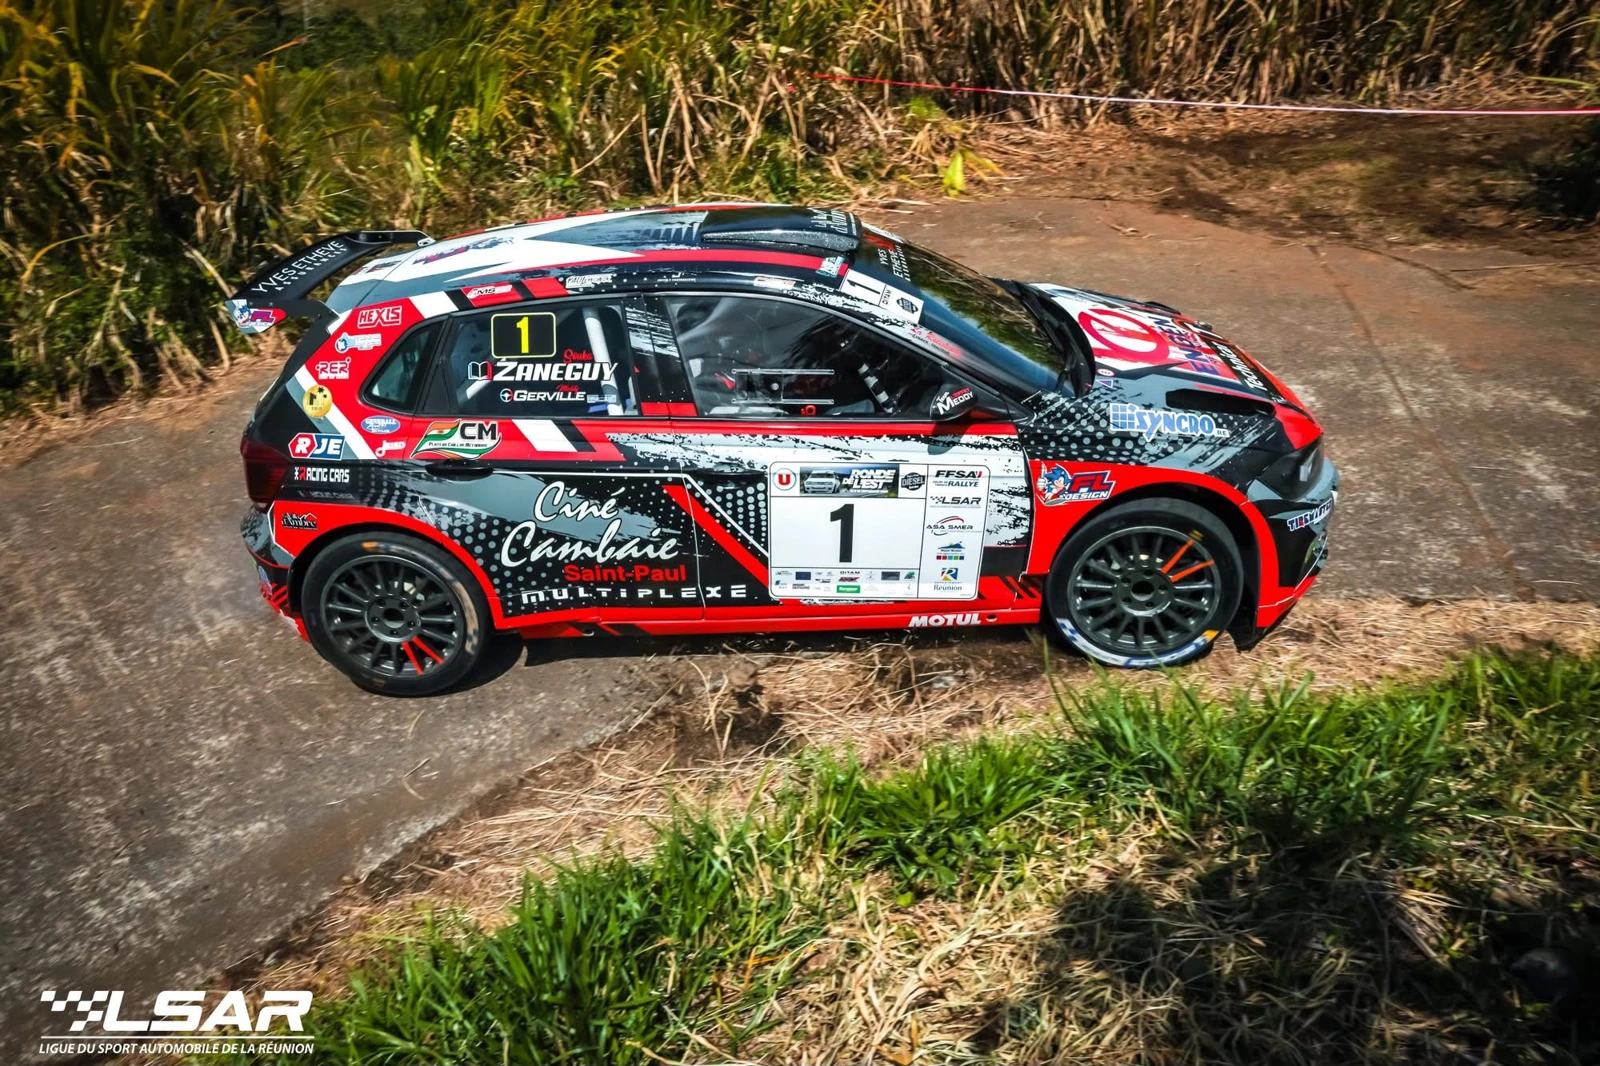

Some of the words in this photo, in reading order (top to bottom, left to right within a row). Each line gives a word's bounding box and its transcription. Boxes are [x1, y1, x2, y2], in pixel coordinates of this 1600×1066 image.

[250, 267, 296, 292] YVES
[291, 241, 344, 269] ETHEVE
[847, 279, 880, 295] 1
[359, 307, 401, 325] HEXIS
[516, 316, 529, 354] 1
[1147, 316, 1220, 376] ENGEN
[320, 362, 348, 374] RER
[493, 361, 618, 381] ZANEGUY
[513, 389, 586, 402] GERVILLE
[937, 391, 973, 415] MEDDY
[460, 423, 497, 440] CM
[294, 437, 342, 455] RJE
[329, 468, 350, 483] CARS
[778, 473, 791, 486] U
[851, 469, 896, 479] RONDE
[901, 476, 925, 487] DIESEL
[1069, 473, 1111, 492] FL
[534, 481, 626, 522] Ciné
[941, 496, 981, 505] LSAR
[1065, 491, 1109, 500] DESIGN
[830, 503, 855, 564] 1
[564, 564, 687, 582] Saint-Paul
[521, 585, 746, 604] MULTIPLEXE
[908, 613, 981, 628] MOTUL
